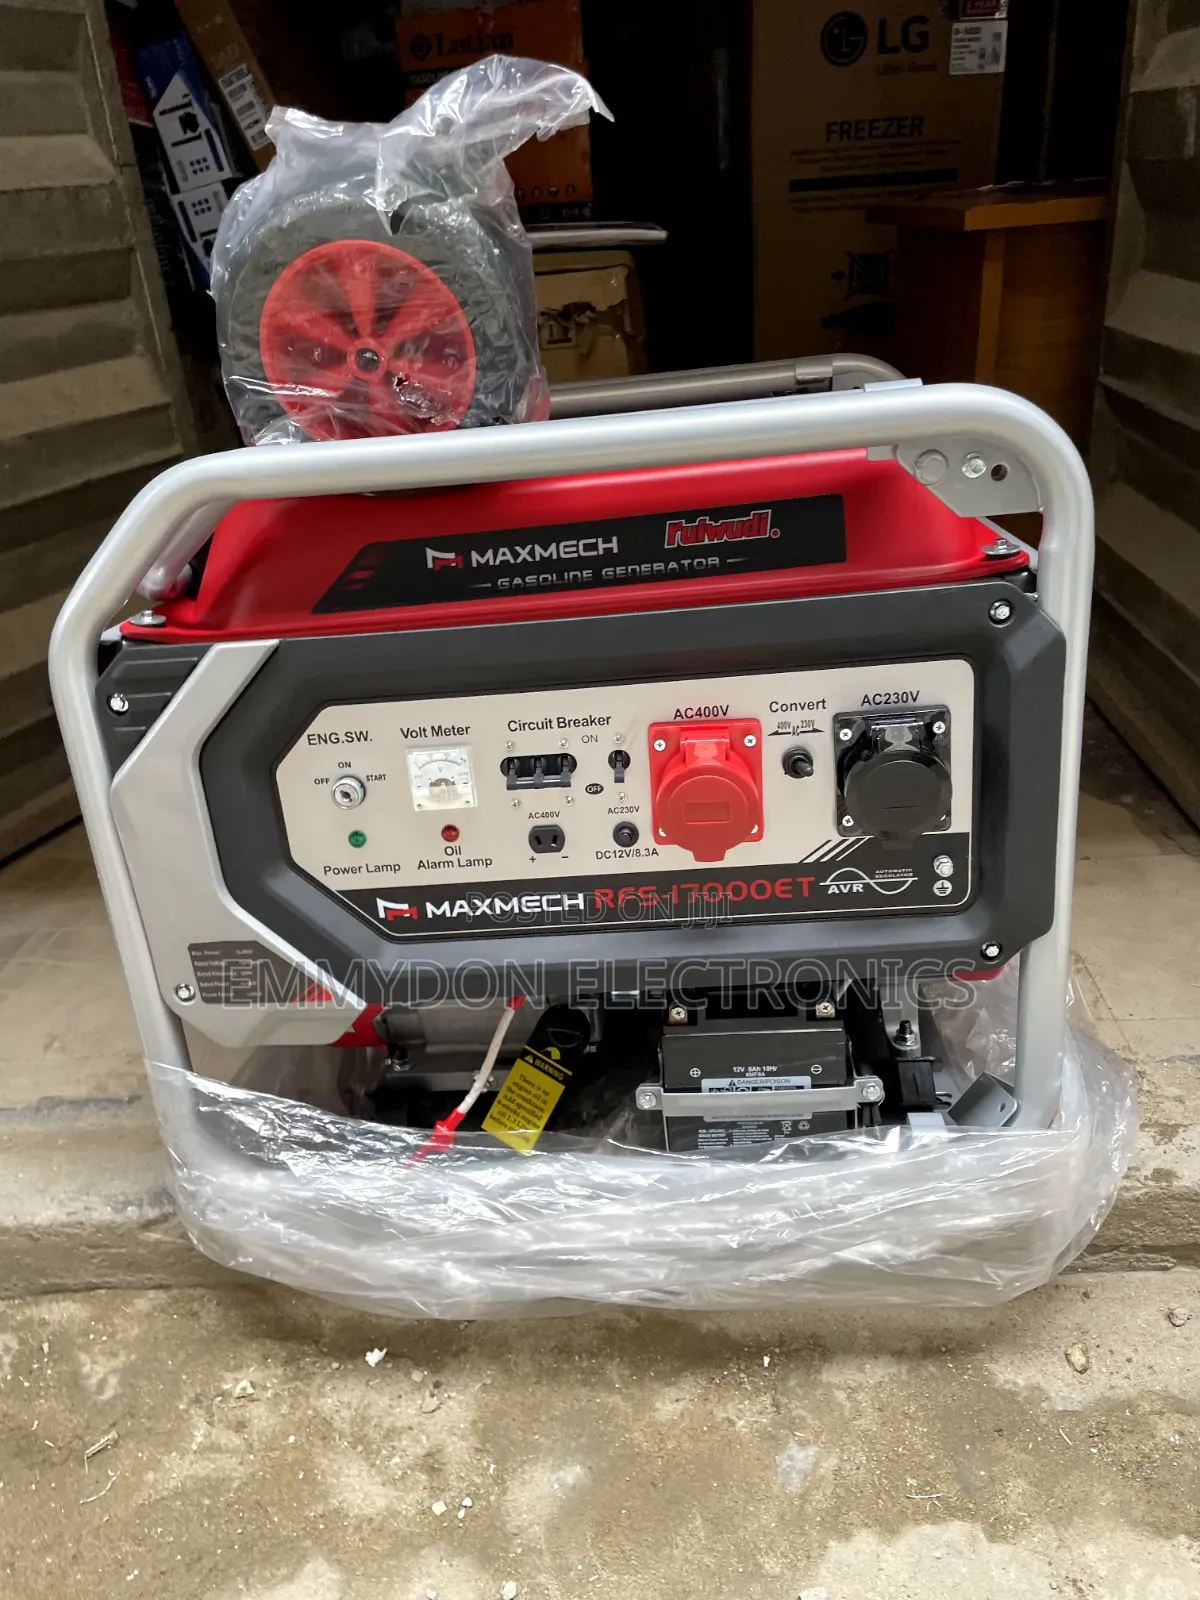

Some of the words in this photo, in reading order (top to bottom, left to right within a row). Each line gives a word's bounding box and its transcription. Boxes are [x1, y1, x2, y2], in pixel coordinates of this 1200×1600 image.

[878, 14, 930, 56] LG
[825, 115, 924, 142] FREEZER
[470, 536, 618, 568] MAXMECH
[497, 570, 593, 590] GASOLINE
[602, 556, 720, 580] GENERATOR
[768, 698, 828, 713] Convert
[860, 690, 920, 707] AC230V
[674, 704, 730, 720] AC400V
[507, 718, 554, 732] Circuit
[556, 714, 612, 729] Breaker
[776, 721, 791, 730] 400V
[792, 725, 800, 737] AC
[800, 719, 816, 730] 230V
[307, 730, 373, 746] ENG.SW.
[400, 726, 428, 740] Volt
[430, 724, 470, 738] Meter
[582, 734, 598, 744] ON
[338, 760, 352, 769] ON
[314, 778, 330, 786] OFF
[366, 774, 387, 782] START
[586, 785, 603, 793] OFF
[528, 810, 560, 820] AC400V
[607, 805, 640, 815] AC230V
[444, 846, 462, 856] Oil
[595, 846, 660, 860] DC12V/8.3A
[323, 865, 362, 876] Power
[365, 862, 402, 874] Lamp
[417, 860, 454, 870] Alarm
[457, 856, 493, 868] Lamp
[828, 884, 864, 894] AVR
[425, 893, 584, 919] MAXMECH
[534, 1058, 564, 1080] WARNING
[519, 1074, 536, 1088] There
